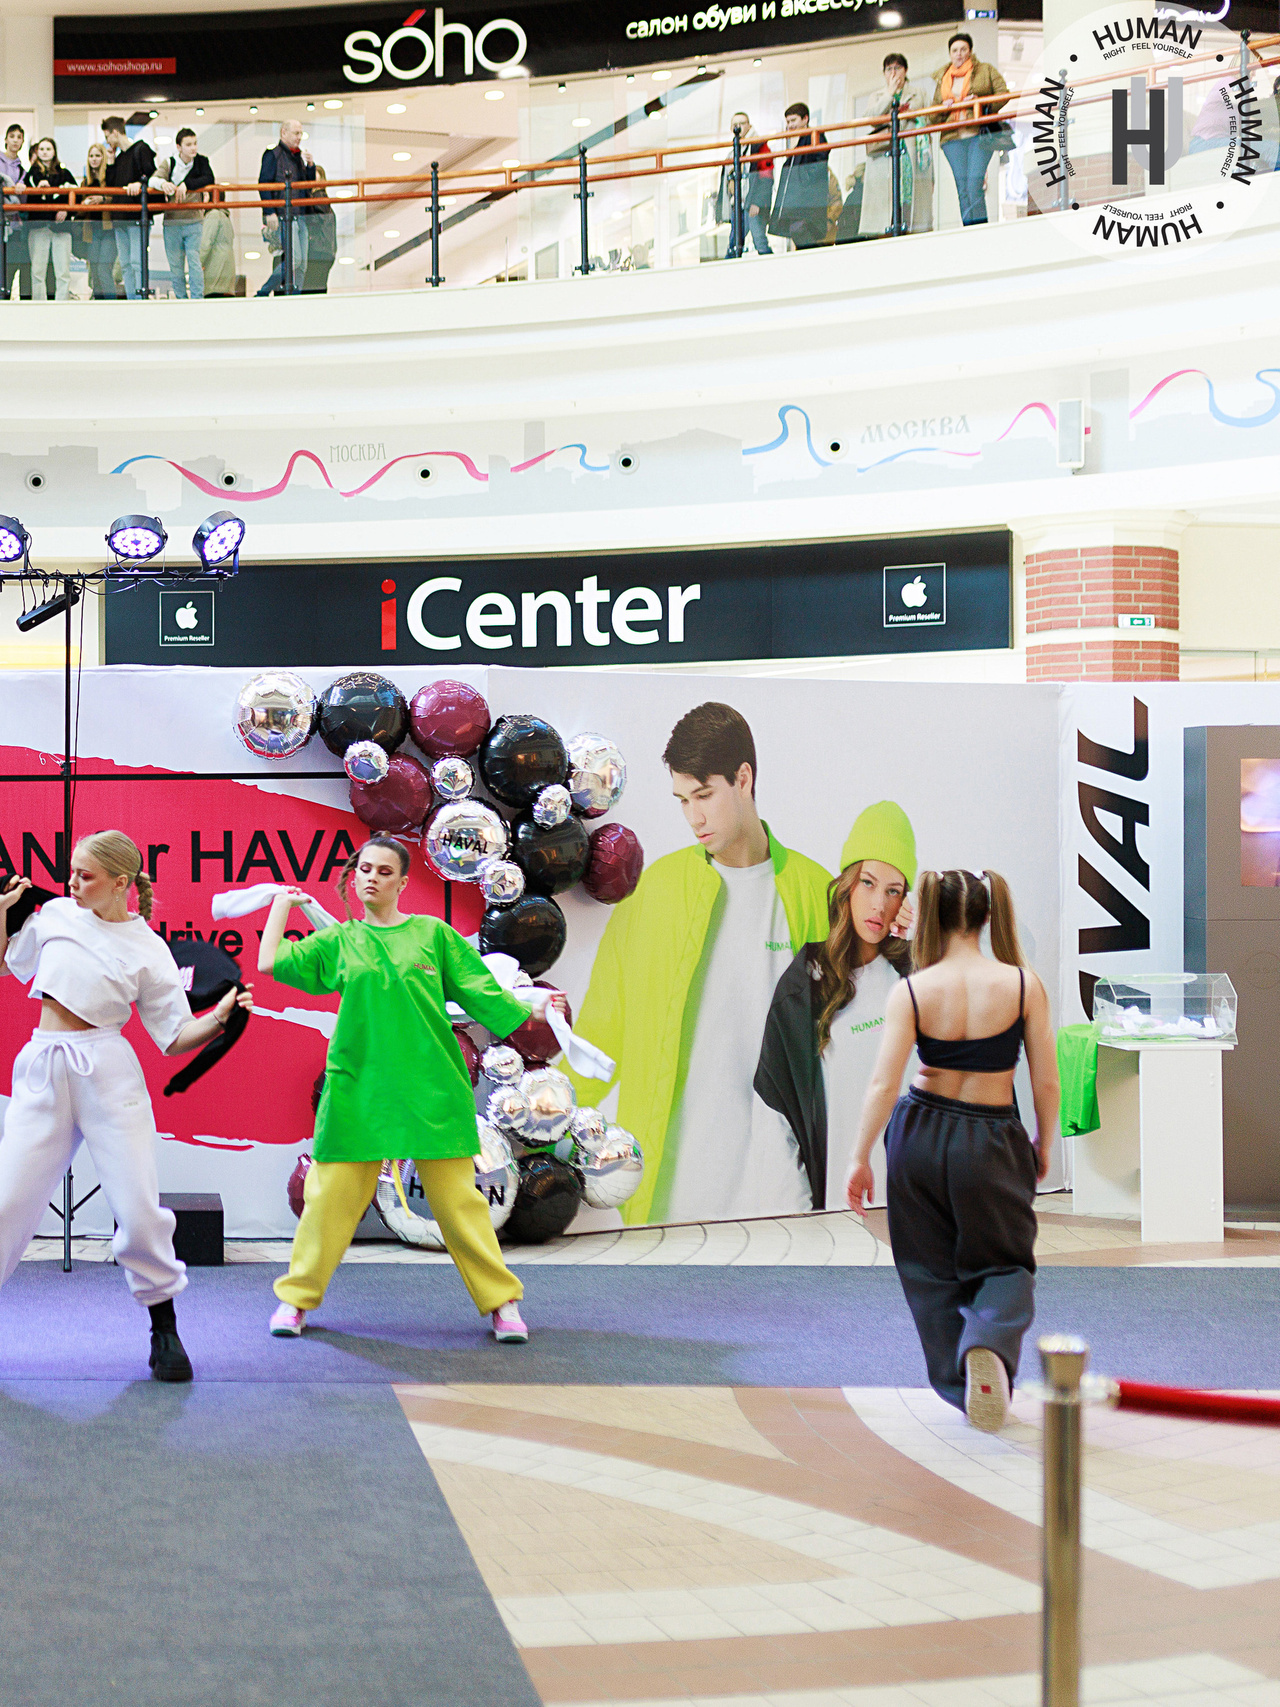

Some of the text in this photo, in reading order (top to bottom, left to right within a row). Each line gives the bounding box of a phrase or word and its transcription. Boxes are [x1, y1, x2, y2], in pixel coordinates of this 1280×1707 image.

[626, 15, 688, 40] салон
[692, 3, 757, 32] обуви
[762, 1, 777, 20] и
[342, 7, 528, 84] sóho
[860, 414, 971, 445] МОСКВА
[329, 443, 387, 463] МОСКВА
[381, 575, 701, 651] iCenter
[191, 829, 377, 883] HAVA
[442, 834, 488, 855] HAVAL
[851, 1016, 886, 1034] HUMAN
